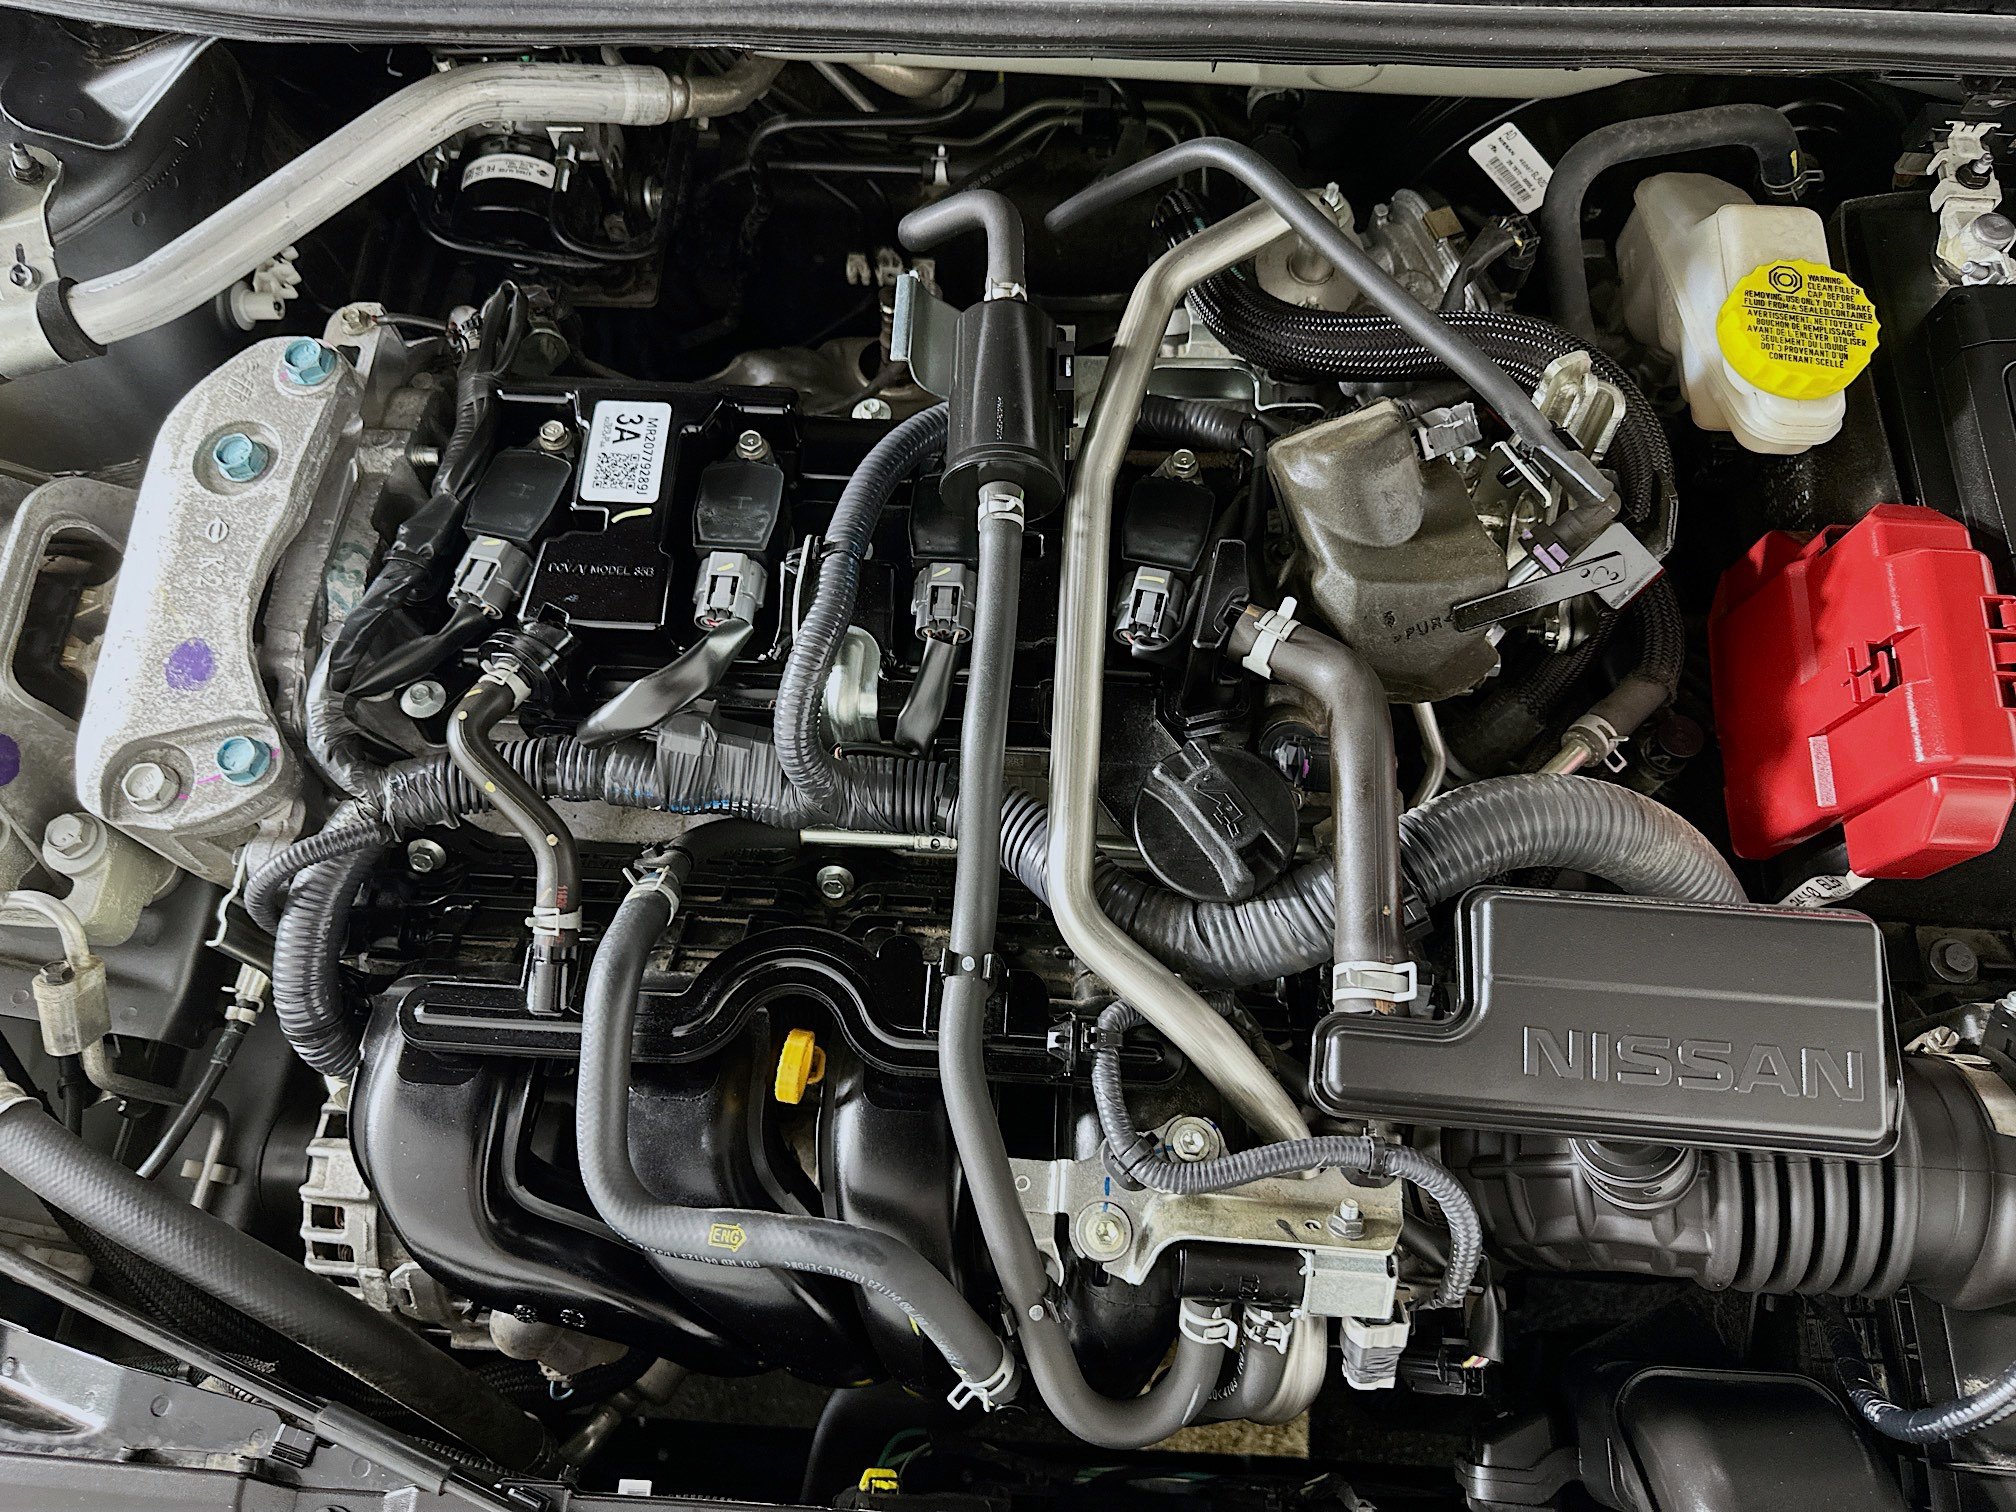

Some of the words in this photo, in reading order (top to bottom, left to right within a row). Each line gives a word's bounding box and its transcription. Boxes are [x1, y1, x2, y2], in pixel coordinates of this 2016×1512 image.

[1807, 283, 1833, 292] CLEAN
[1834, 286, 1860, 295] FILLER
[1785, 296, 1800, 304] USE
[1801, 297, 1820, 306] ONLY
[1823, 300, 1838, 308] DOT
[1846, 303, 1871, 312] BRAKE
[1827, 293, 1854, 302] BEFORE
[1744, 298, 1765, 307] FLUID
[1768, 301, 1788, 310] FROM
[1800, 305, 1829, 315] SEALED
[1831, 309, 1872, 321] CONTAINER
[1756, 318, 1790, 329] BOUCHON
[1792, 322, 1800, 330] DE
[1803, 324, 1856, 337] REMPLISSAGE
[1814, 318, 1853, 329] NETTOYER
[1855, 323, 1864, 331] LE
[1747, 325, 1773, 333] AVANT
[1833, 336, 1866, 347] UTILISER
[1761, 335, 1805, 347] SEULEMENT
[1820, 342, 1848, 352] LIQUIDE
[1761, 342, 1775, 350] DOT
[1784, 345, 1829, 358] PROVENANT
[1769, 352, 1813, 364] CONTENANT
[1815, 358, 1844, 368] SCELLÉ
[612, 413, 644, 444] 3A
[636, 417, 659, 496] MR20779289J
[590, 564, 631, 576] MODEL
[1523, 1025, 1865, 1102] NISSAN
[712, 1228, 741, 1244] ENG
